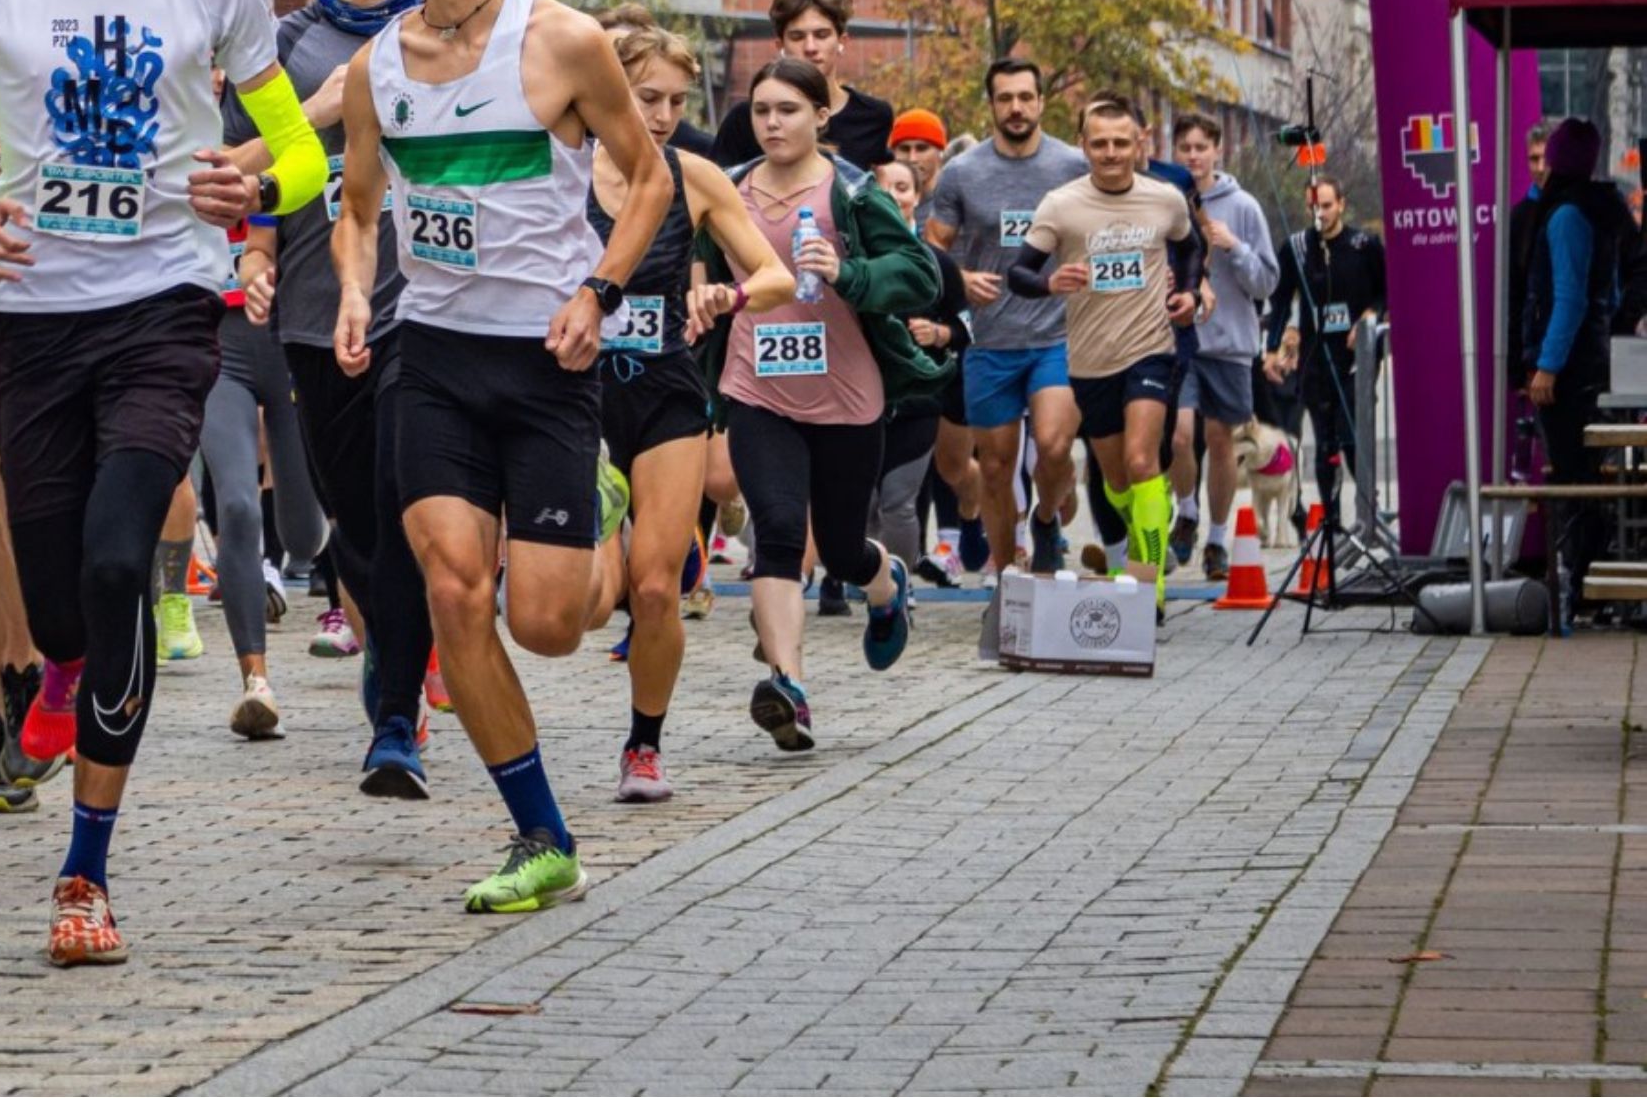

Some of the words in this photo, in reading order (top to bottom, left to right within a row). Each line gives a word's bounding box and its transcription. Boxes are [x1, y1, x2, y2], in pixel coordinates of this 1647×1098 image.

[51, 18, 79, 33] 2023
[39, 179, 140, 221] 216
[1393, 204, 1497, 230] KATOWC
[410, 209, 474, 252] 236
[1095, 260, 1142, 281] 284
[758, 335, 823, 362] 288
